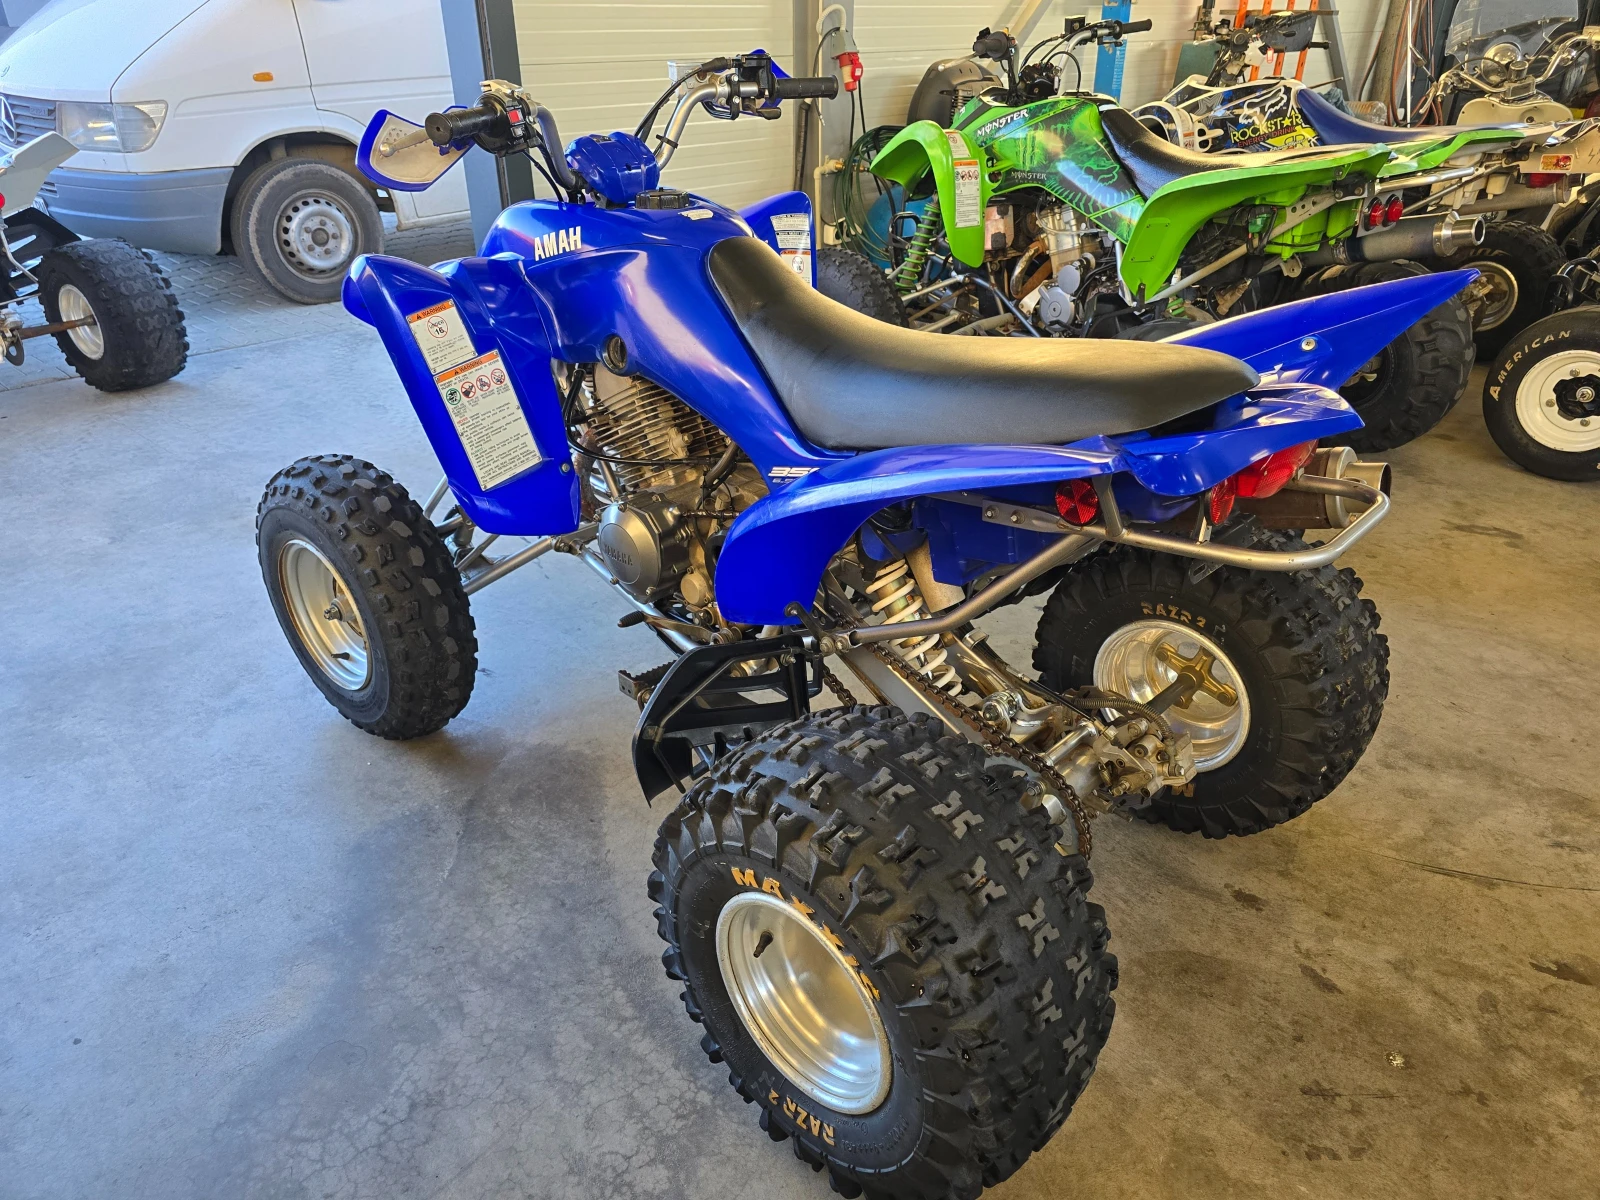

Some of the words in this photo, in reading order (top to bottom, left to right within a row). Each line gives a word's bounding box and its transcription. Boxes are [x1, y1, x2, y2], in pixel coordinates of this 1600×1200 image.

[977, 108, 1029, 137] MONSTER
[1238, 134, 1269, 147] ENERGY
[1271, 126, 1296, 138] DRINK
[1011, 171, 1047, 181] MONSTER
[421, 304, 447, 317] WARNING
[435, 327, 445, 335] 16
[460, 360, 483, 373] WARNING
[1489, 330, 1571, 401] AMERICAN
[1141, 600, 1192, 624] RAZR
[783, 1096, 835, 1146] RAZR
